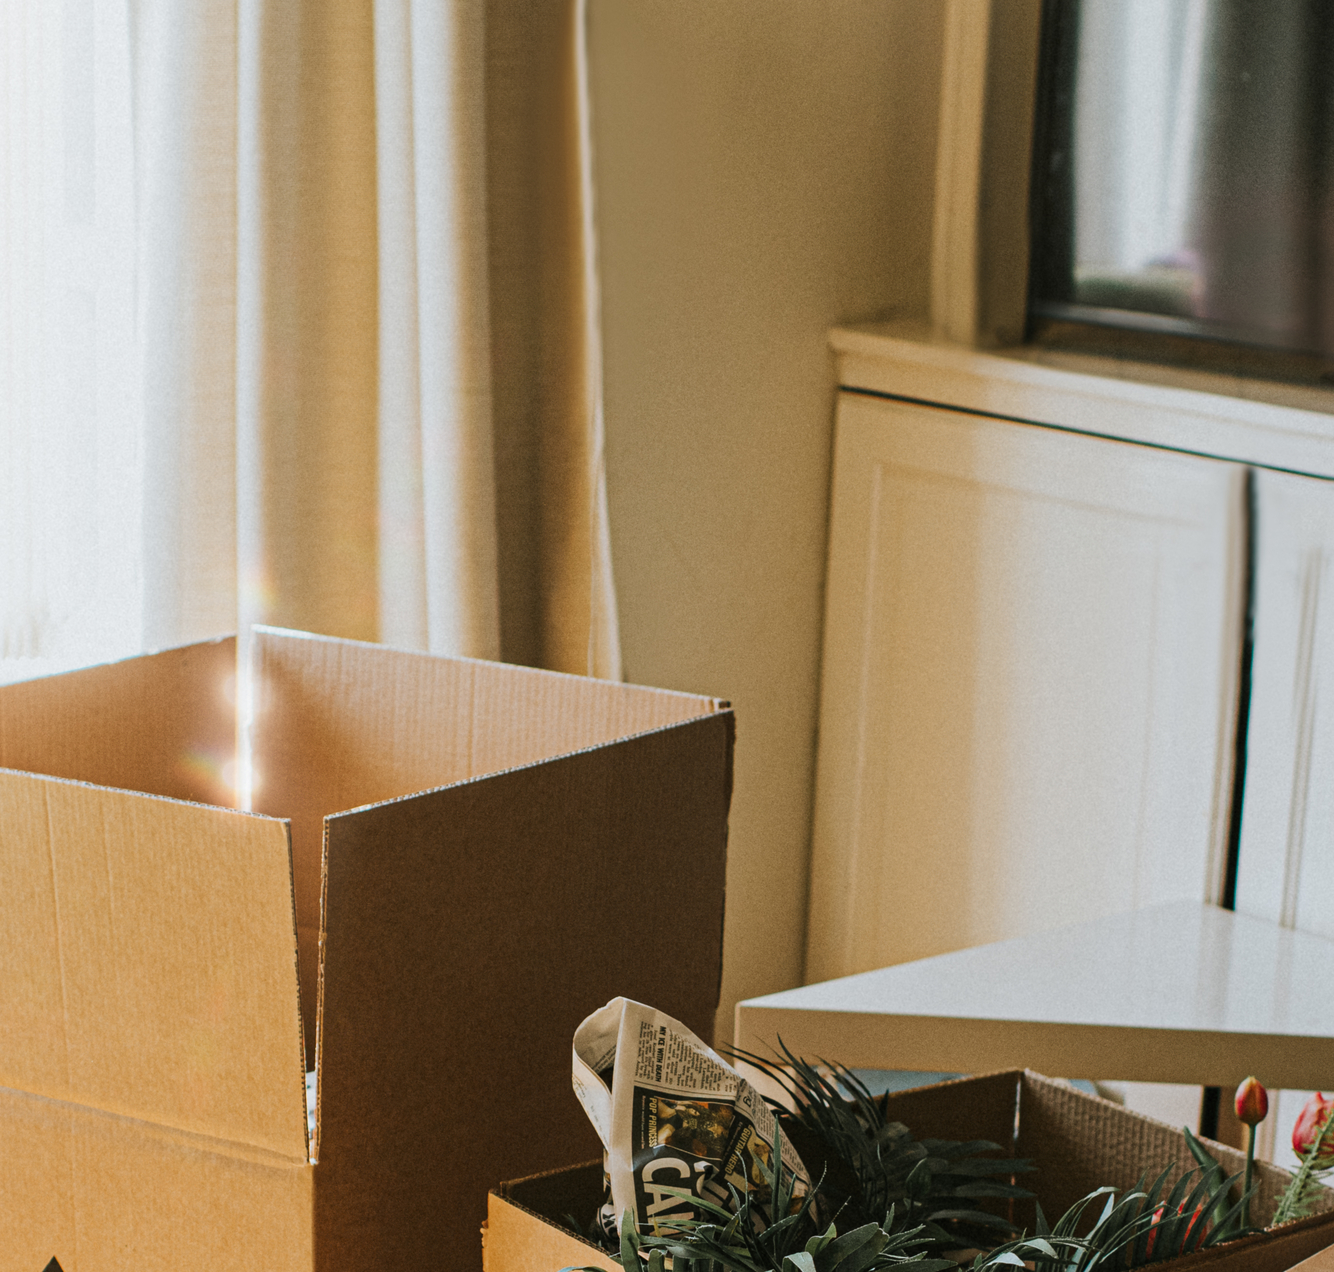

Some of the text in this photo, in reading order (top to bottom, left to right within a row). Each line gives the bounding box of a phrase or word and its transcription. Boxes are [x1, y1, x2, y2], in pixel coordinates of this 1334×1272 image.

[659, 1025, 667, 1036] MY
[656, 1047, 664, 1064] WITH
[648, 1097, 657, 1148] POP PRINCESS
[735, 1127, 751, 1154] GUITAR
[724, 1154, 740, 1175] HERO
